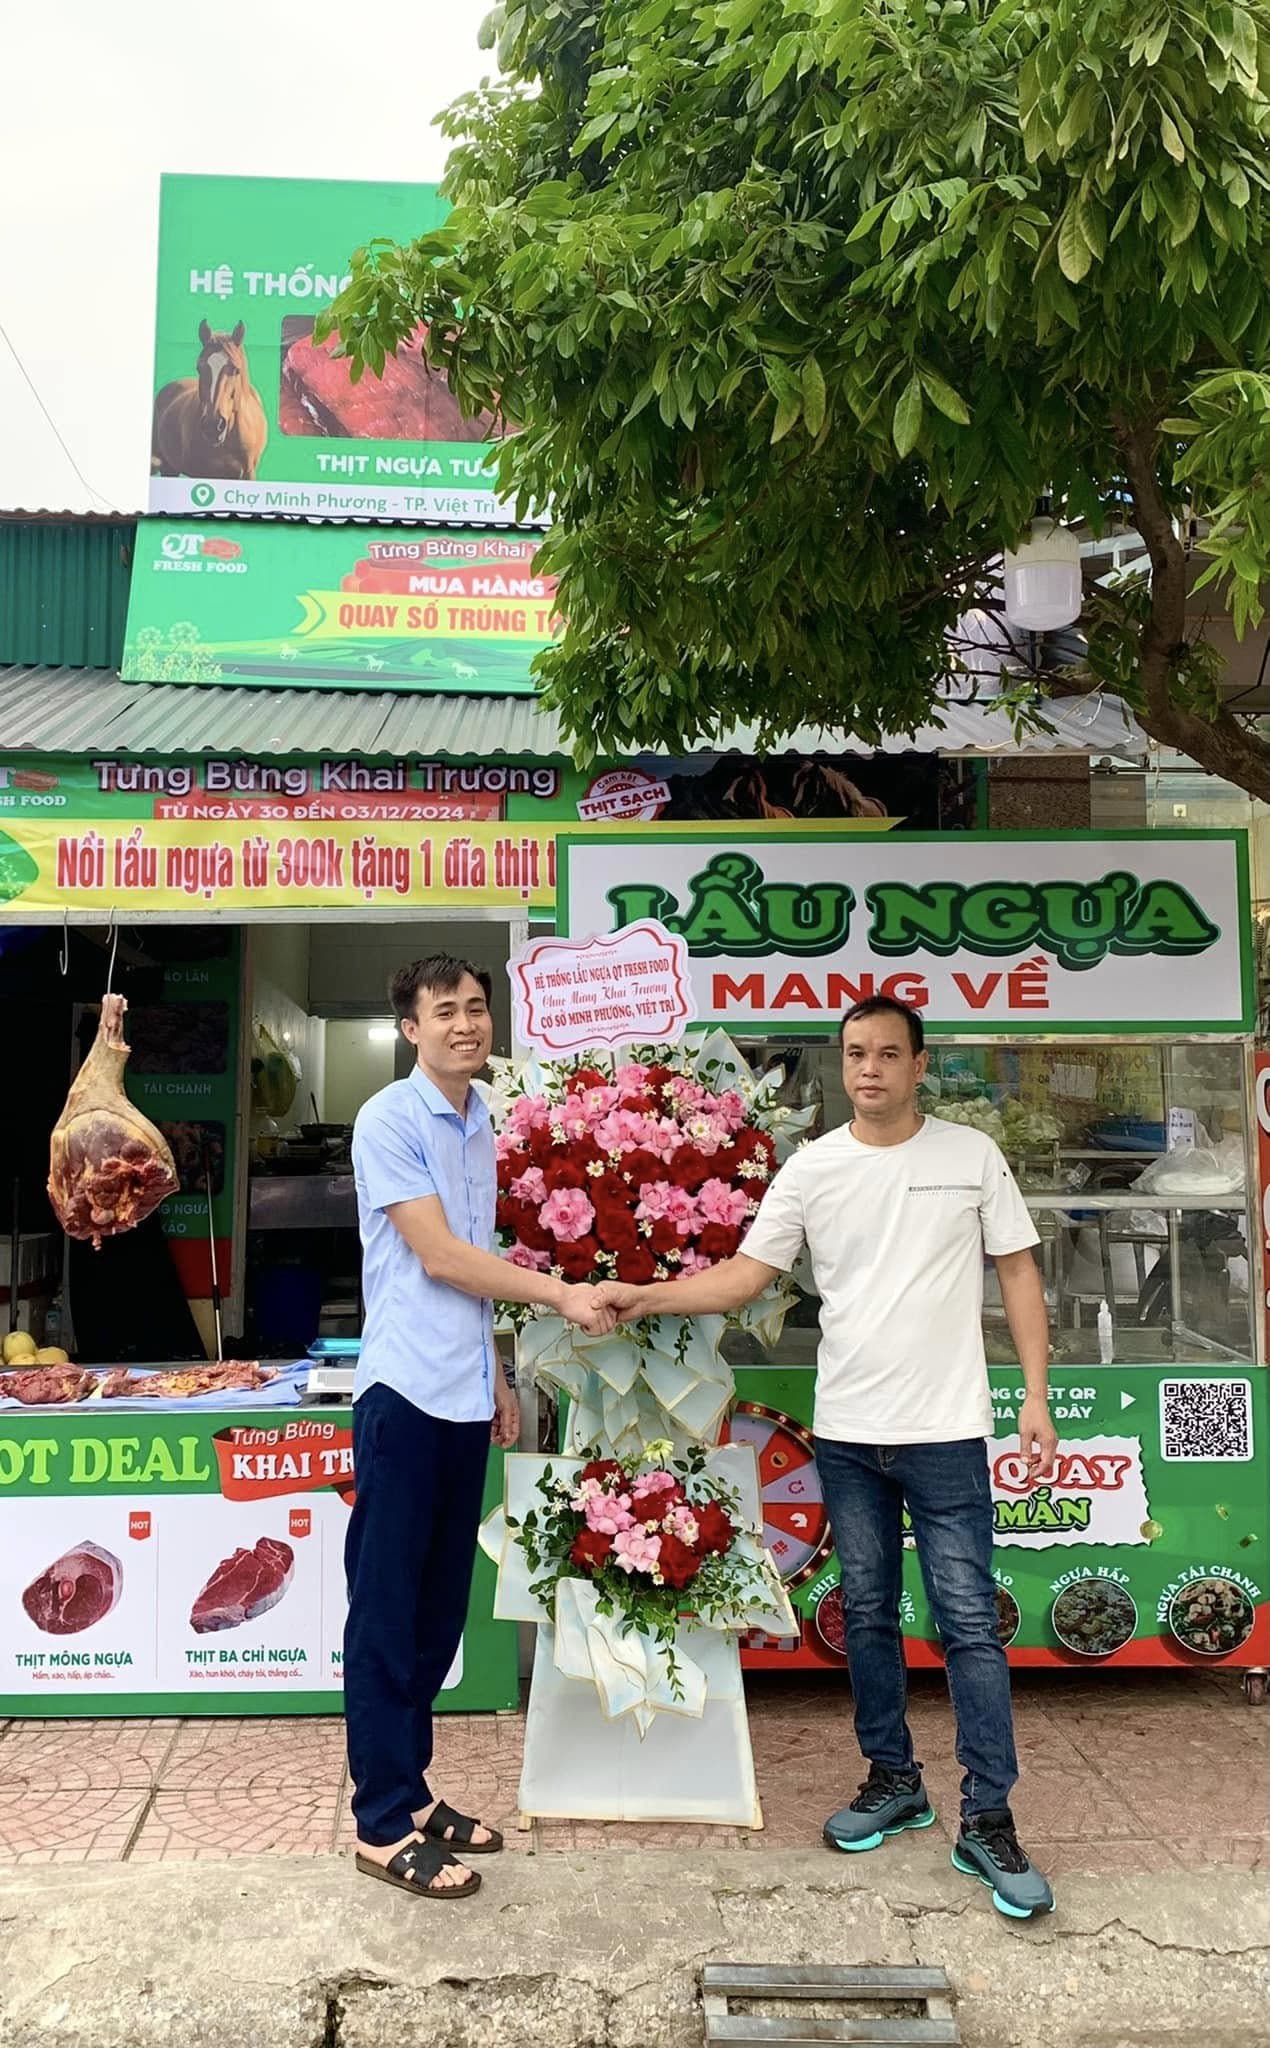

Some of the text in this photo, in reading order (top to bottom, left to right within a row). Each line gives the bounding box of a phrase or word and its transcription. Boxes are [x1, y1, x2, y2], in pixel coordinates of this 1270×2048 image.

[189, 264, 234, 300] HỆ
[316, 454, 369, 477] THỊT
[375, 456, 443, 479] NGỰA
[224, 490, 260, 507] Chợ
[265, 492, 311, 507] Minh
[317, 494, 387, 512] Phương
[404, 496, 427, 511] TP.
[434, 498, 468, 516] Việt
[474, 500, 495, 514] Trì
[161, 533, 205, 559] QT
[370, 543, 420, 561] Tưng
[426, 539, 477, 557] Bừng
[484, 541, 526, 558] Khai
[153, 560, 248, 573] FRESH FOOD
[409, 575, 545, 596] MUA HÀNG
[339, 603, 399, 629] QUAY
[407, 599, 439, 629] SỐ
[447, 604, 526, 632] TRÚNG
[94, 761, 556, 797] Tưng Bừng Khai Trương
[21, 796, 66, 806] FOOD
[160, 800, 464, 819] TỪ NGÀY 30 ĐẾN 03/12/2024
[580, 787, 666, 815] THỊT SẠCH
[57, 830, 104, 887] Nồi
[115, 827, 157, 887] lẩu
[167, 842, 233, 898] ngựa
[243, 836, 270, 887] từ
[277, 838, 343, 887] 300k
[352, 836, 411, 898] tặng
[420, 839, 431, 887] 1
[445, 838, 486, 887] đĩa
[494, 838, 539, 898] thịt
[605, 852, 856, 957] LẨU
[865, 870, 1222, 971] NGỰA
[624, 961, 648, 976] FRESH
[649, 958, 669, 973] FOOD
[713, 955, 1049, 1009] MANG VỀ
[568, 1010, 593, 1025] MINH
[166, 1083, 212, 1095] CHANH
[1014, 1384, 1066, 1400] QÉT
[1069, 1387, 1096, 1400] QR
[1054, 1403, 1093, 1419] ĐÂY
[231, 1428, 280, 1446] Tưng
[0, 1437, 210, 1484] OT DEAL
[232, 1452, 312, 1480] KHAI
[993, 1487, 1092, 1533] MẮN
[130, 1520, 149, 1530] HOT
[290, 1518, 309, 1528] HOT
[992, 1567, 1013, 1586] ÀO
[1049, 1566, 1131, 1593] NGỰA HẤP
[1157, 1565, 1262, 1622] NGỰA TÁI CHANH
[16, 1650, 133, 1669] THỊT MÔNG NGỰA
[185, 1650, 216, 1665] THỊT
[219, 1650, 238, 1662] BA
[268, 1648, 307, 1665] NGỰA
